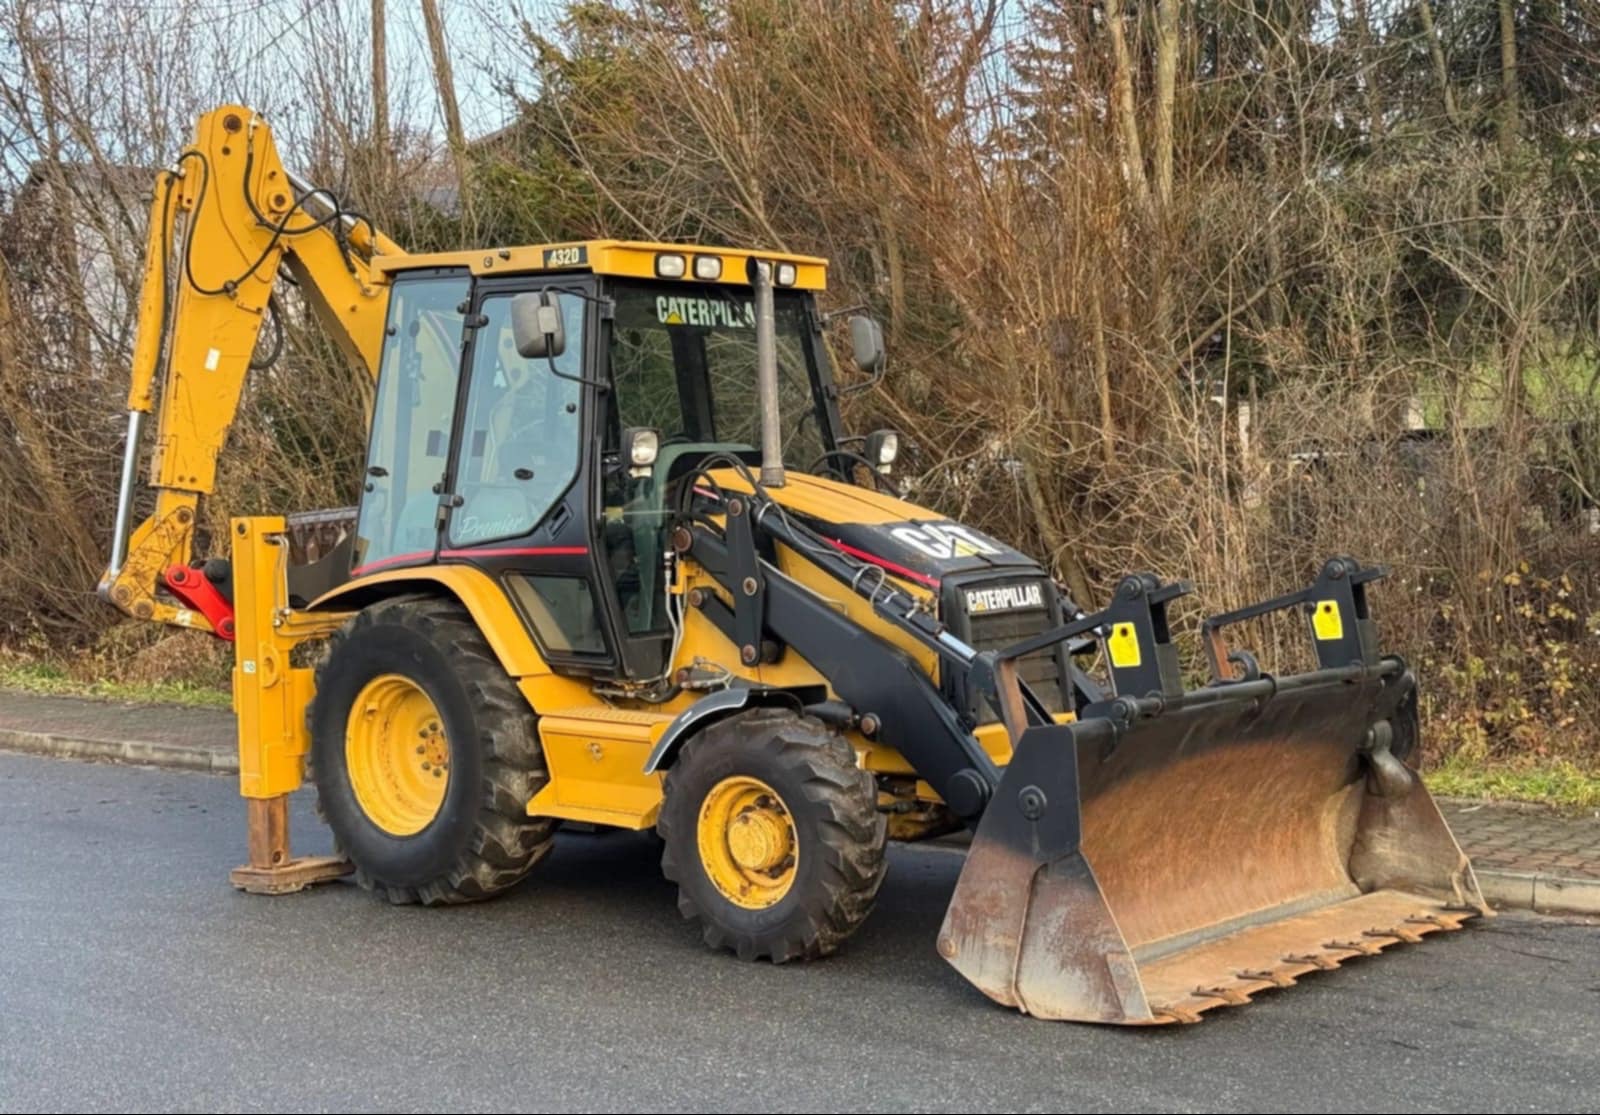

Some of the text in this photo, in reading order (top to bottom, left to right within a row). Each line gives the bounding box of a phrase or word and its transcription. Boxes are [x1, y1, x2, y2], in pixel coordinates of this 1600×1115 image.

[549, 247, 580, 265] 432D
[656, 295, 757, 328] CATERPILLA
[891, 523, 1002, 558] CAT
[967, 585, 1041, 612] CATERPILLAR
